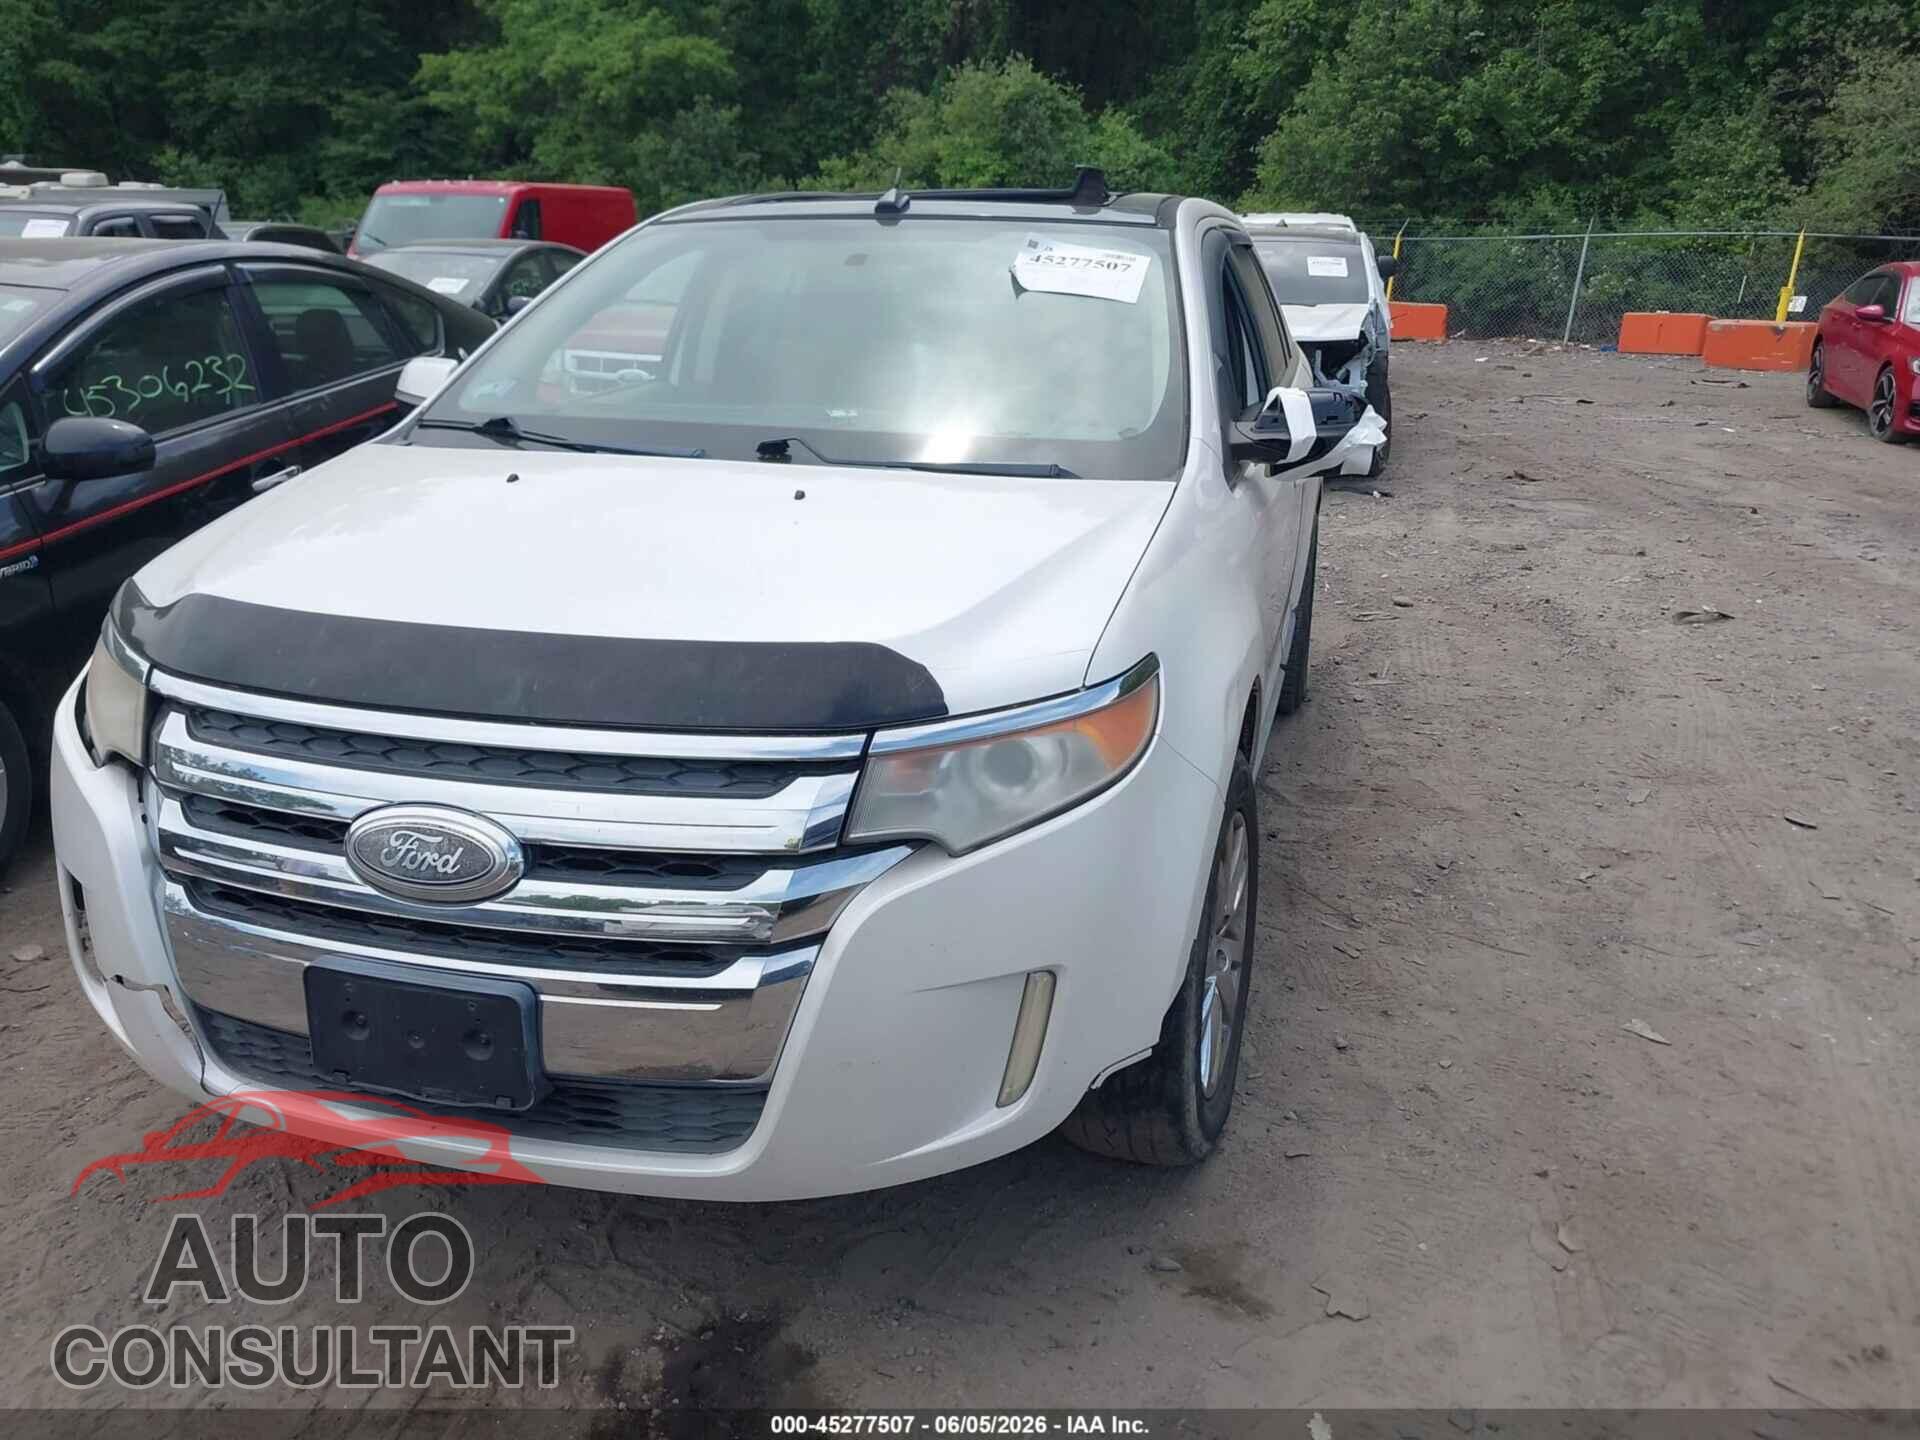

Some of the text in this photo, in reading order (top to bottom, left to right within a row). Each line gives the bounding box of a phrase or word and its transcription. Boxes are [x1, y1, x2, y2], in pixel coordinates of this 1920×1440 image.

[1029, 254, 1132, 273] 45277507
[64, 354, 256, 417] 45306232
[382, 830, 463, 874] Ford
